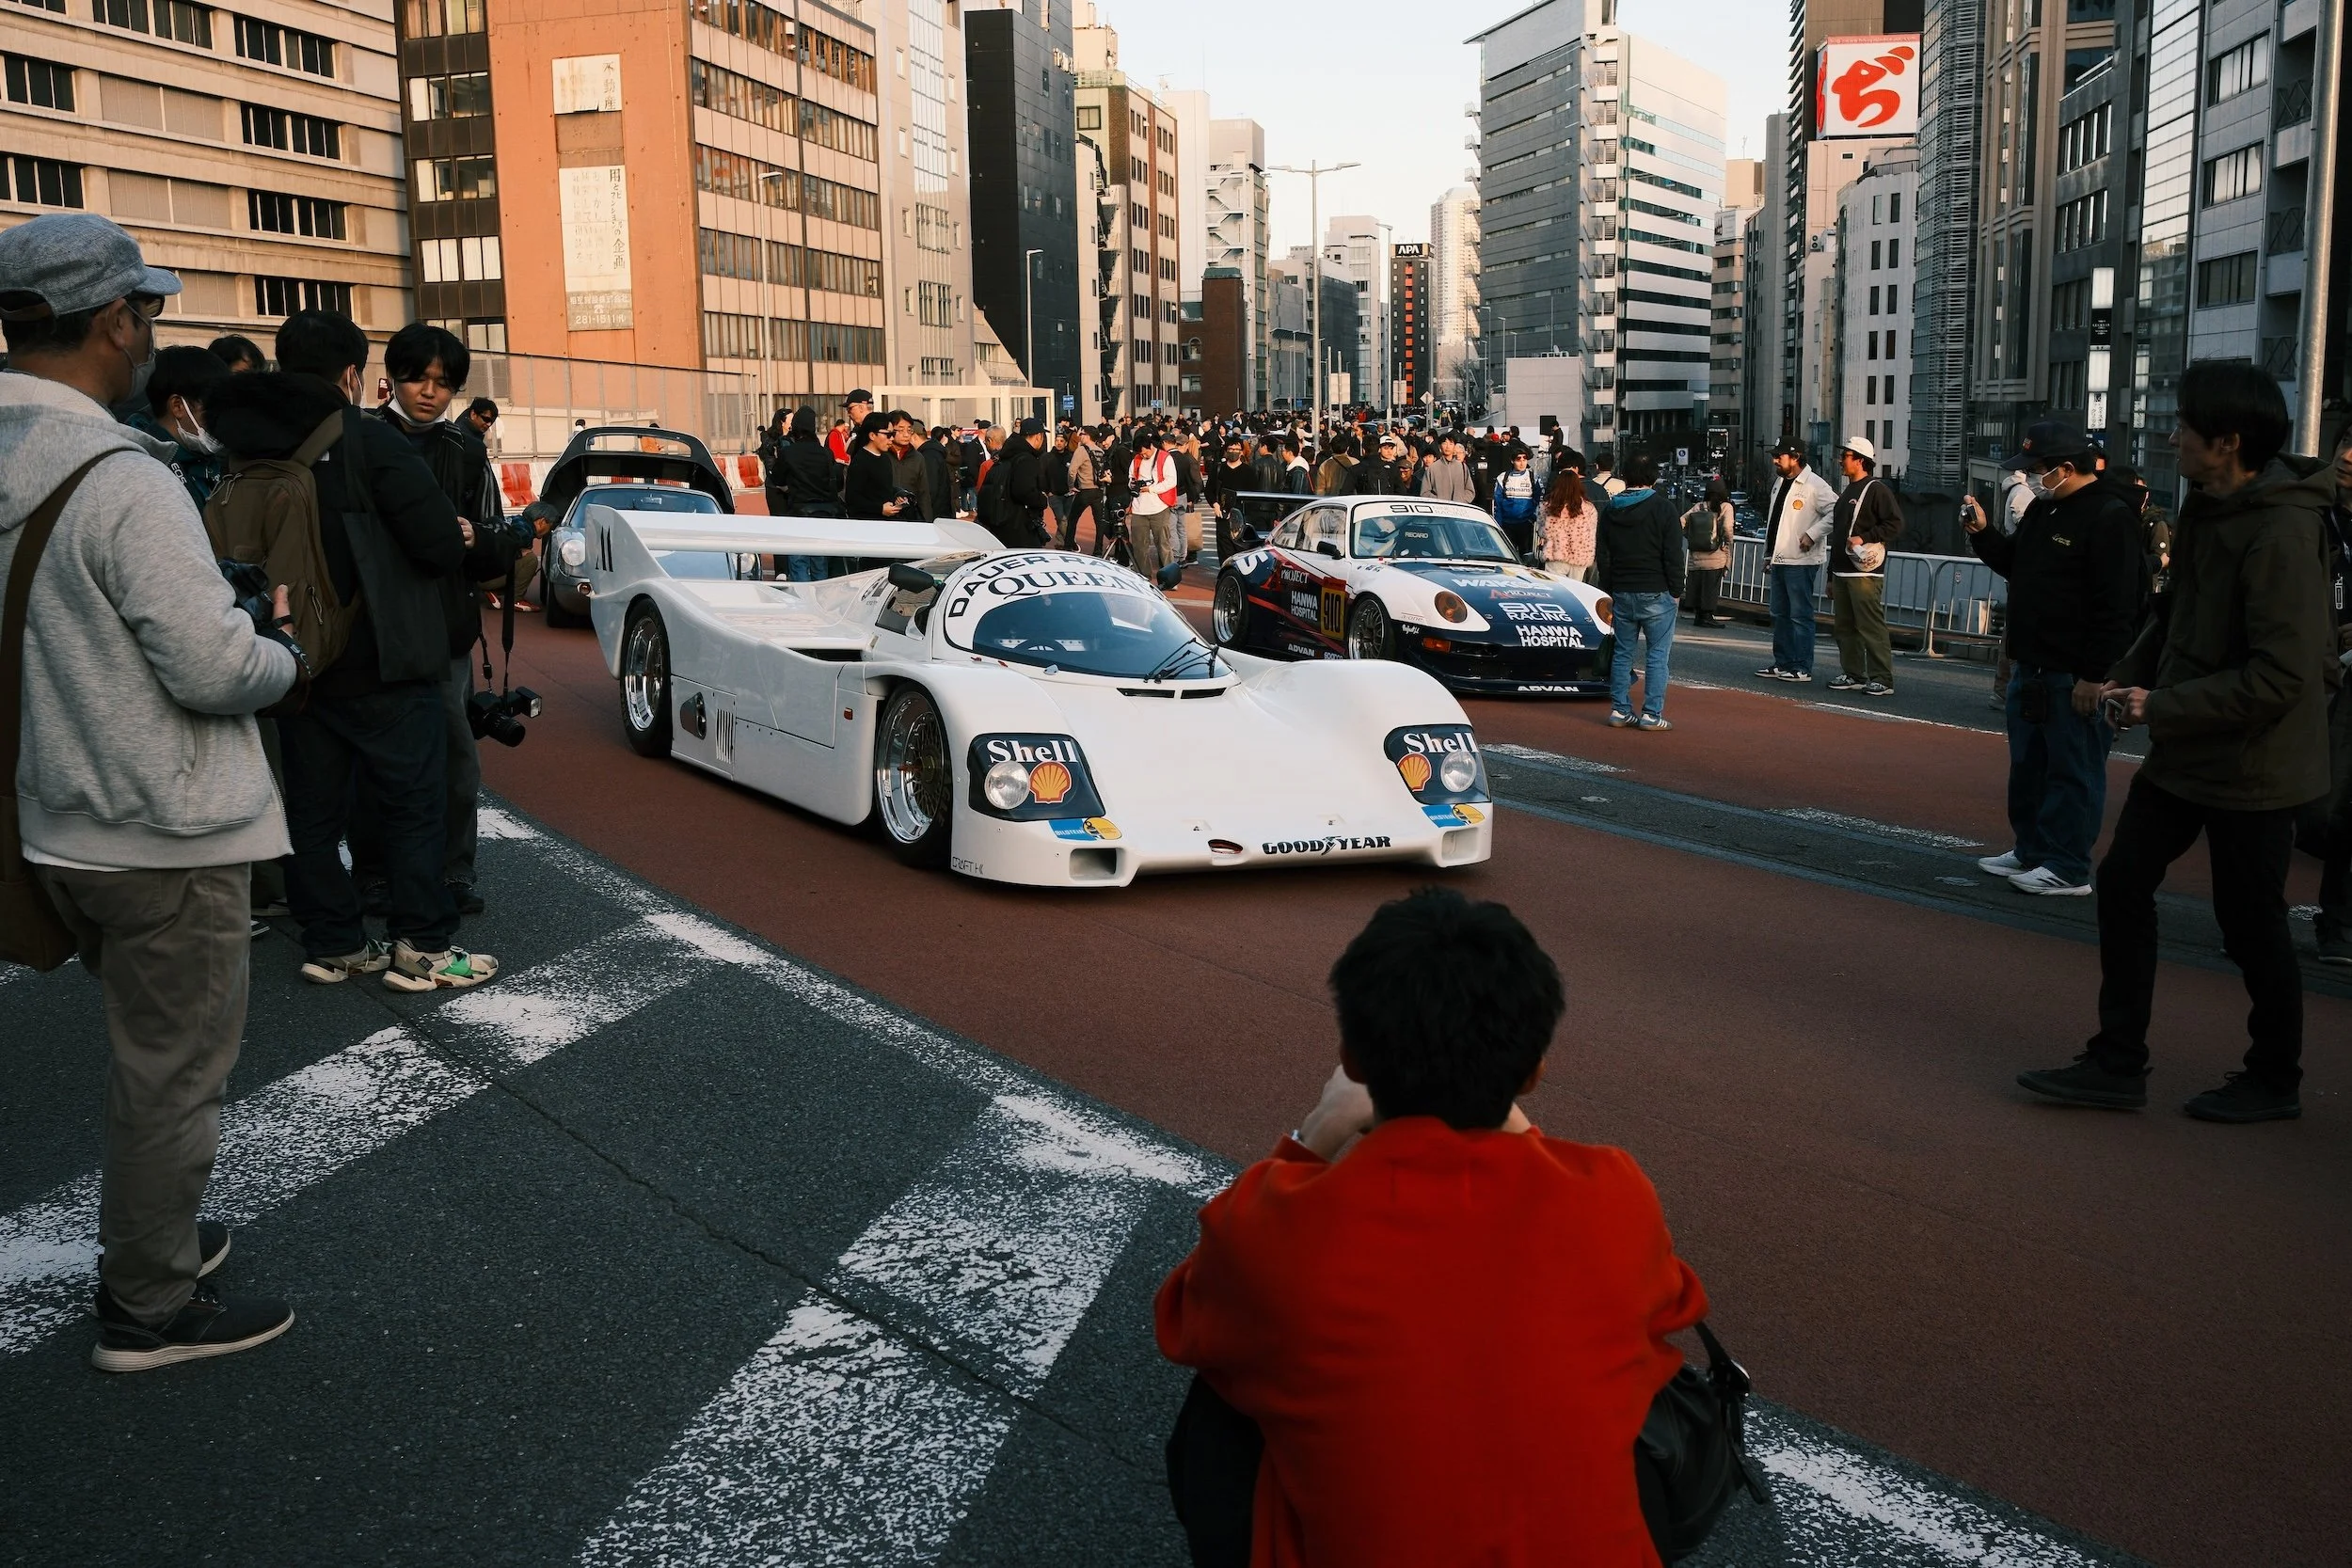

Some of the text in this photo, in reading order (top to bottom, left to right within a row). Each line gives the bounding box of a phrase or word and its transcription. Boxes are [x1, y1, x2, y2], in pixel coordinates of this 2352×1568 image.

[1398, 245, 1420, 254] APA
[170, 462, 187, 484] EOS
[1390, 505, 1434, 514] 910
[1291, 591, 1317, 610] HANWA
[1291, 605, 1317, 621] HOSPITAL
[1323, 592, 1343, 633] 910
[1498, 602, 1566, 614] 910
[1506, 612, 1572, 622] RACING
[1516, 625, 1582, 639] HANWA
[1520, 636, 1585, 648] HOSPITAL
[1288, 643, 1315, 657] ADVAN
[1403, 733, 1479, 753] Shell
[987, 739, 1079, 763] Shell
[1054, 828, 1086, 836] BILSTEIN
